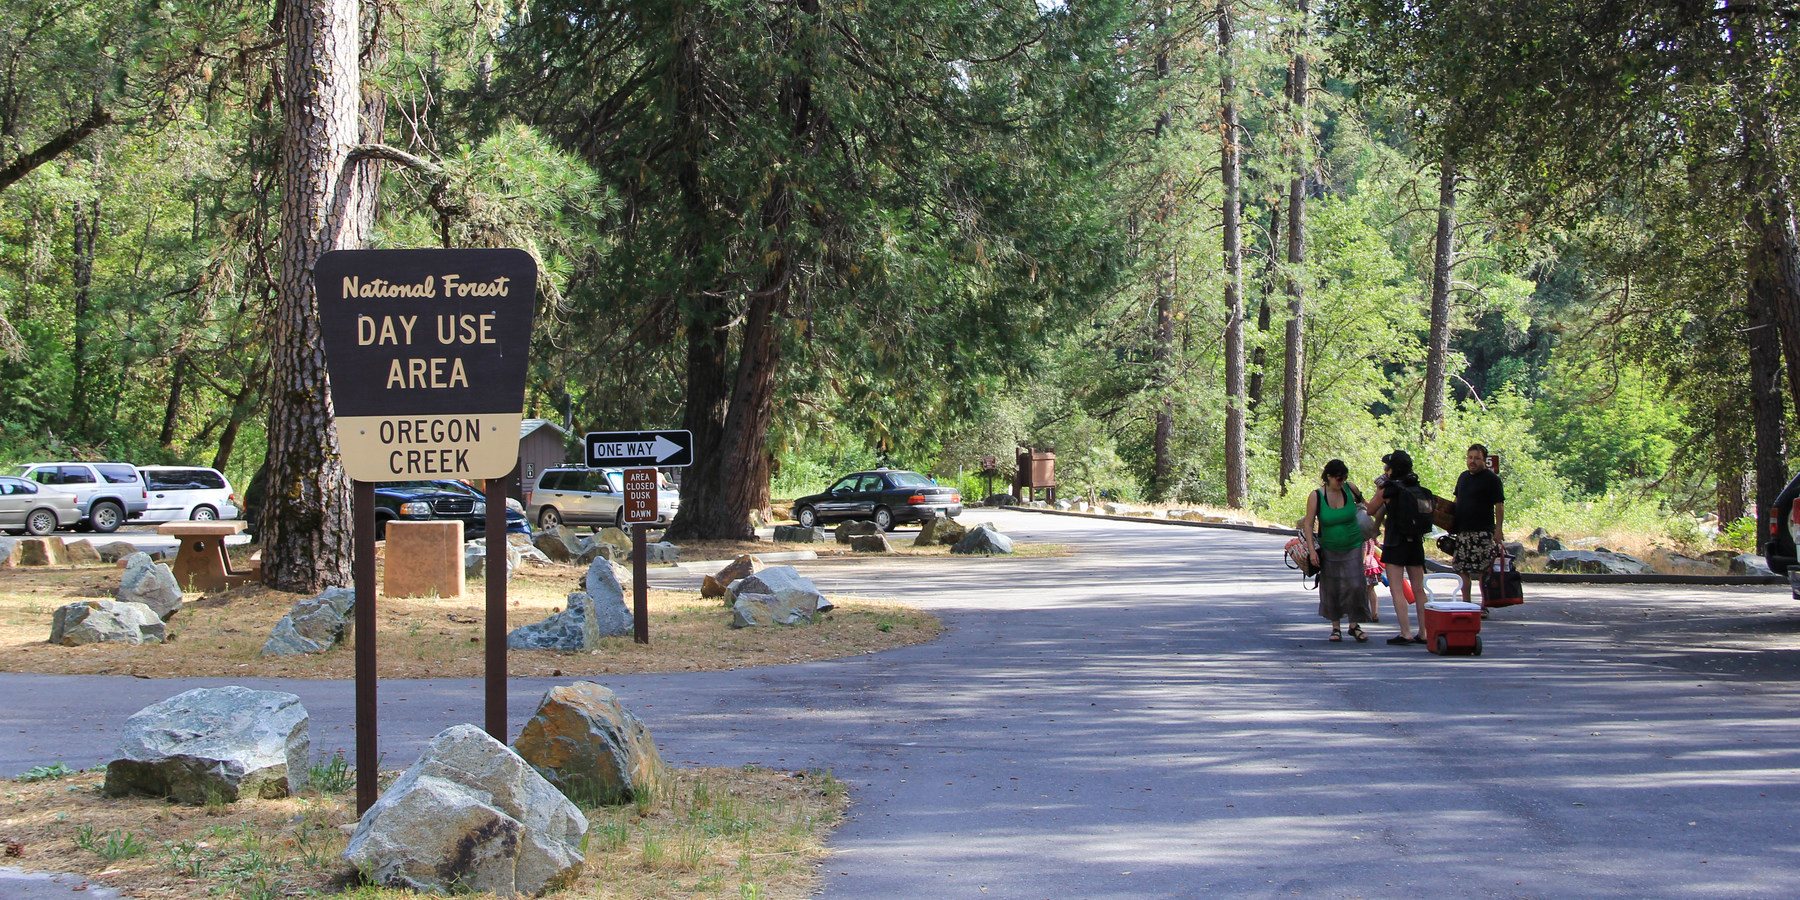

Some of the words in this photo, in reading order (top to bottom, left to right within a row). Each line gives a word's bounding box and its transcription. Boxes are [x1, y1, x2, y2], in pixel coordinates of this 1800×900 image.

[342, 275, 436, 299] National
[441, 274, 511, 298] Forest
[357, 315, 418, 346] DAY
[437, 314, 497, 345] USE
[386, 357, 469, 389] AREA
[379, 418, 481, 444] OREGON
[597, 443, 623, 457] ONE
[627, 442, 654, 456] WAY
[389, 449, 470, 475] CREEK
[630, 473, 650, 481] AREA
[626, 482, 655, 490] CLOSED
[630, 491, 651, 499] DUSK
[636, 501, 646, 509] TO
[630, 510, 652, 518] DAWN
